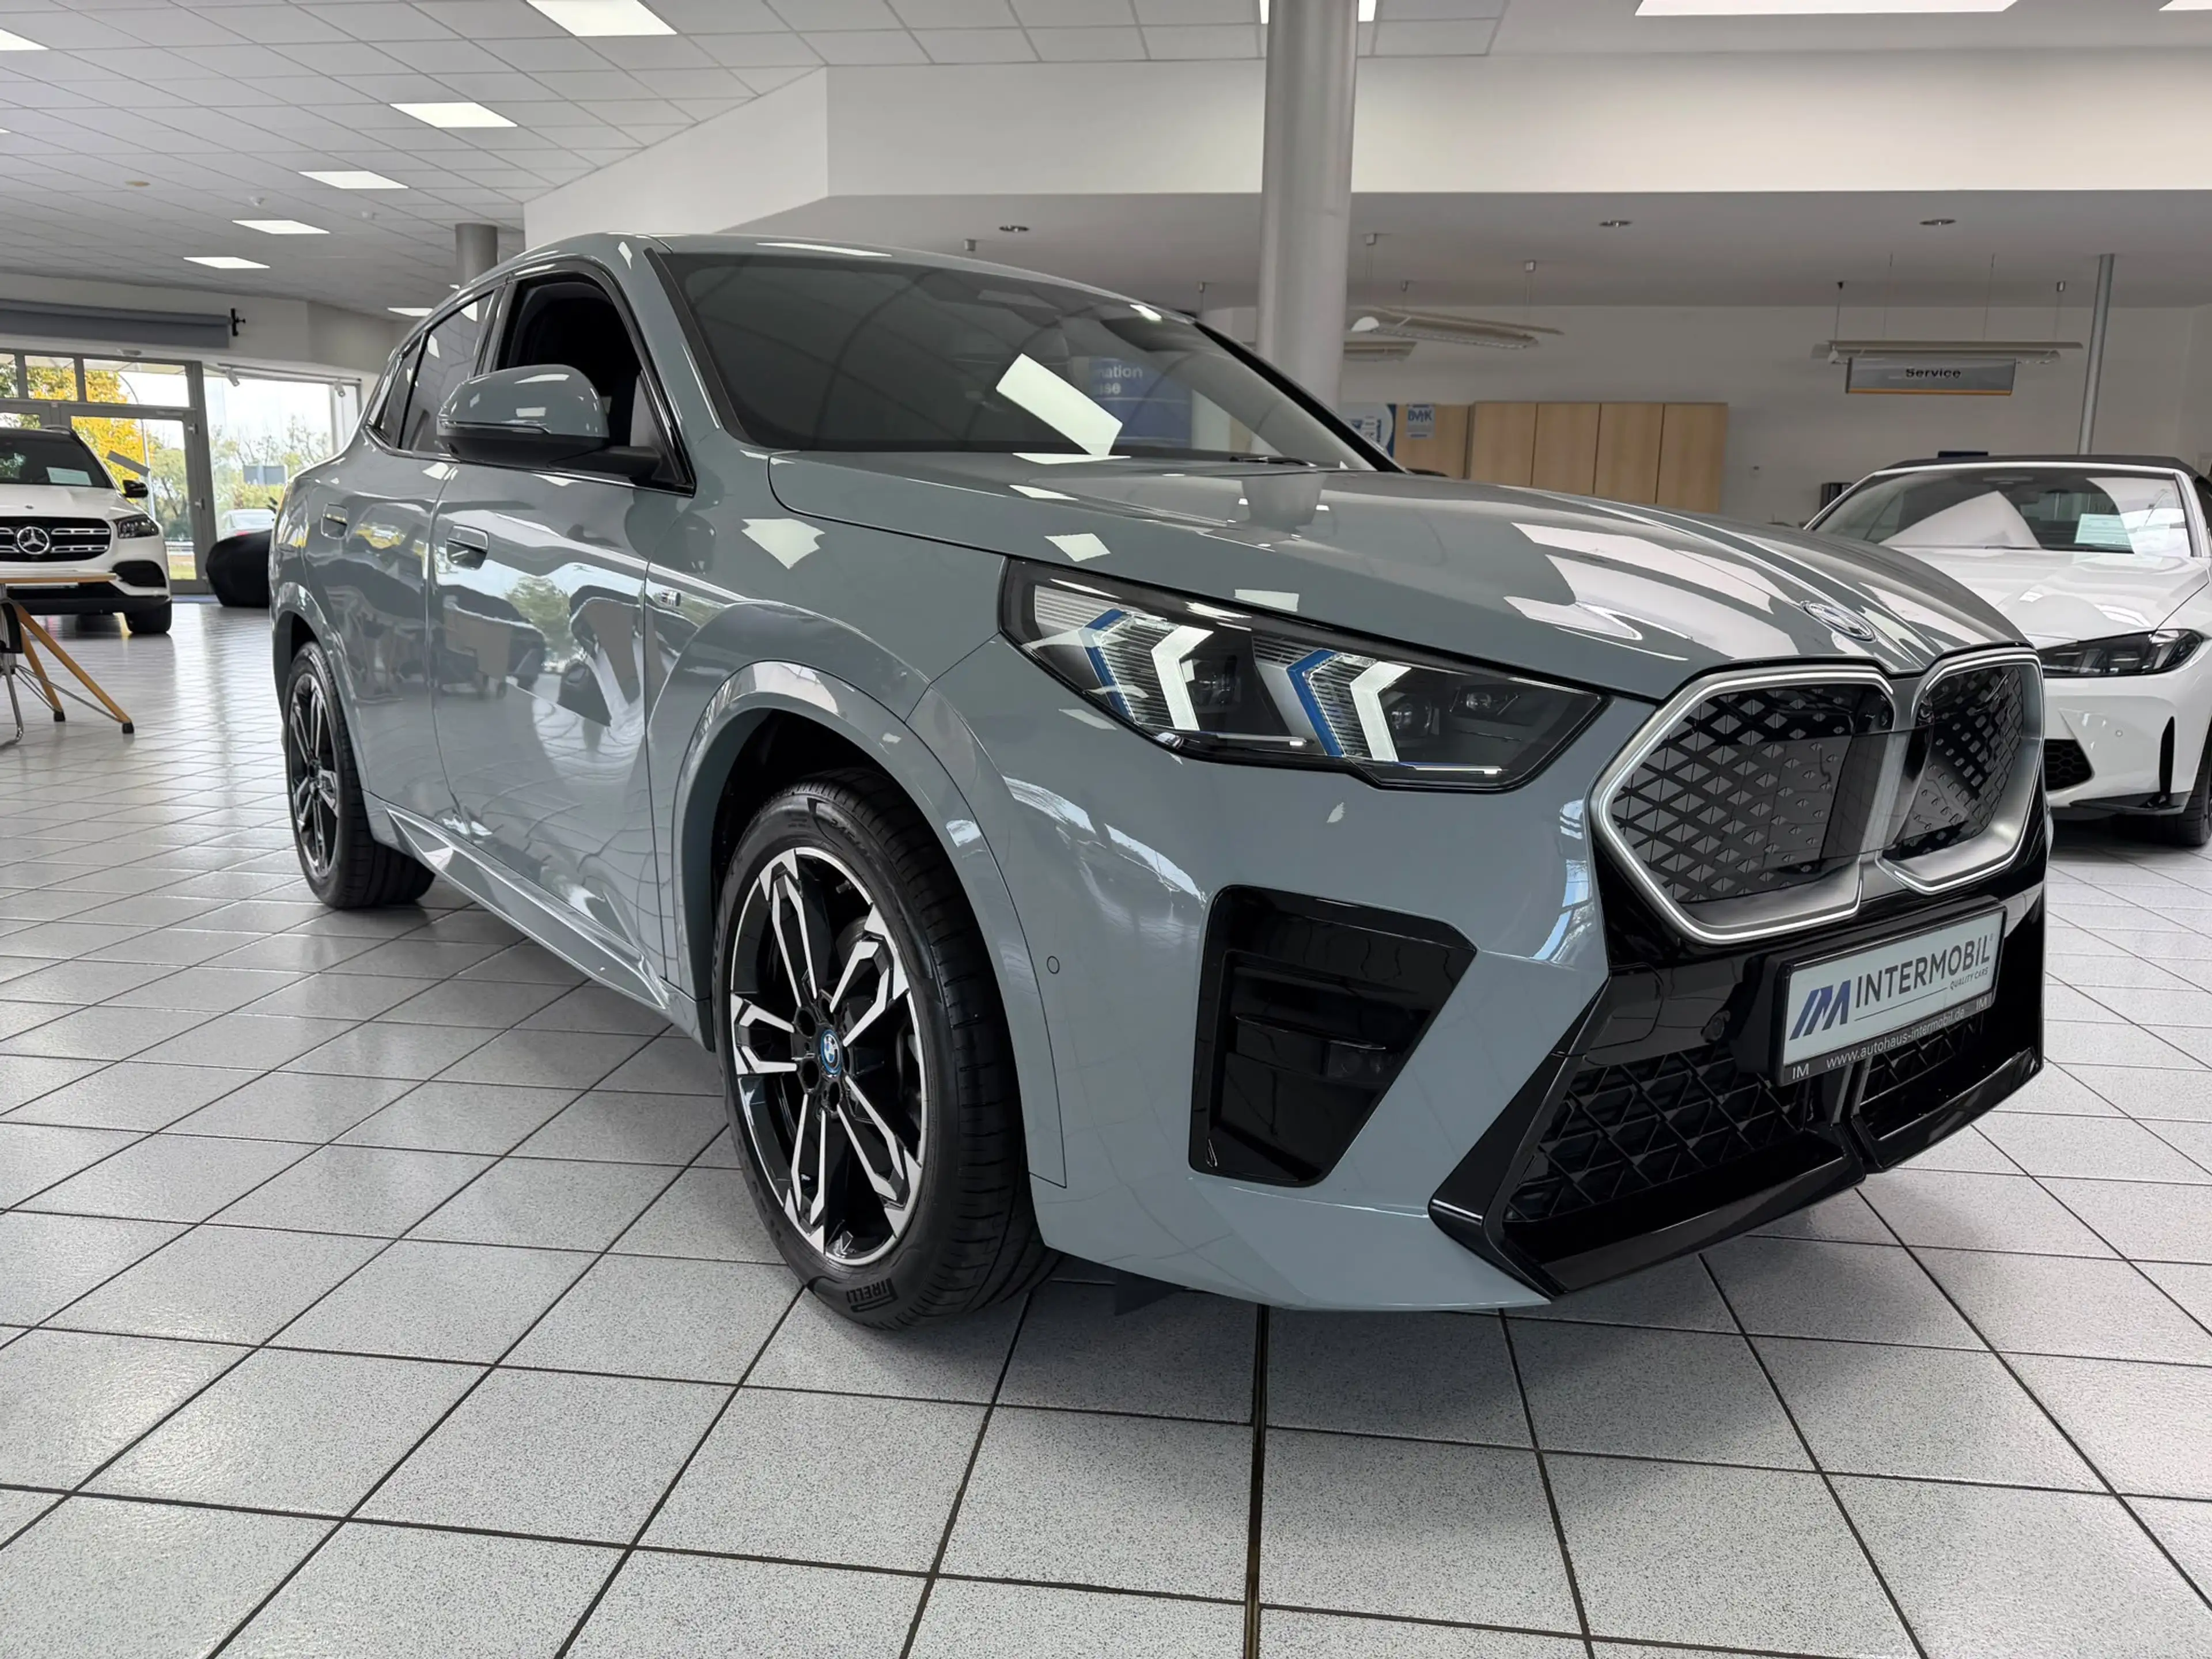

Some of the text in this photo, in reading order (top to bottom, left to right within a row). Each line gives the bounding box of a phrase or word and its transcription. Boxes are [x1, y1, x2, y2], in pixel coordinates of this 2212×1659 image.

[1906, 368, 1961, 379] Service
[1855, 934, 1990, 1009] INTERMOBIL
[1950, 967, 1988, 990] QUALITY CARS
[1792, 997, 1987, 1080] IM www.autohaus-intermobil.de IM
[846, 1277, 899, 1312] PIRELLI
